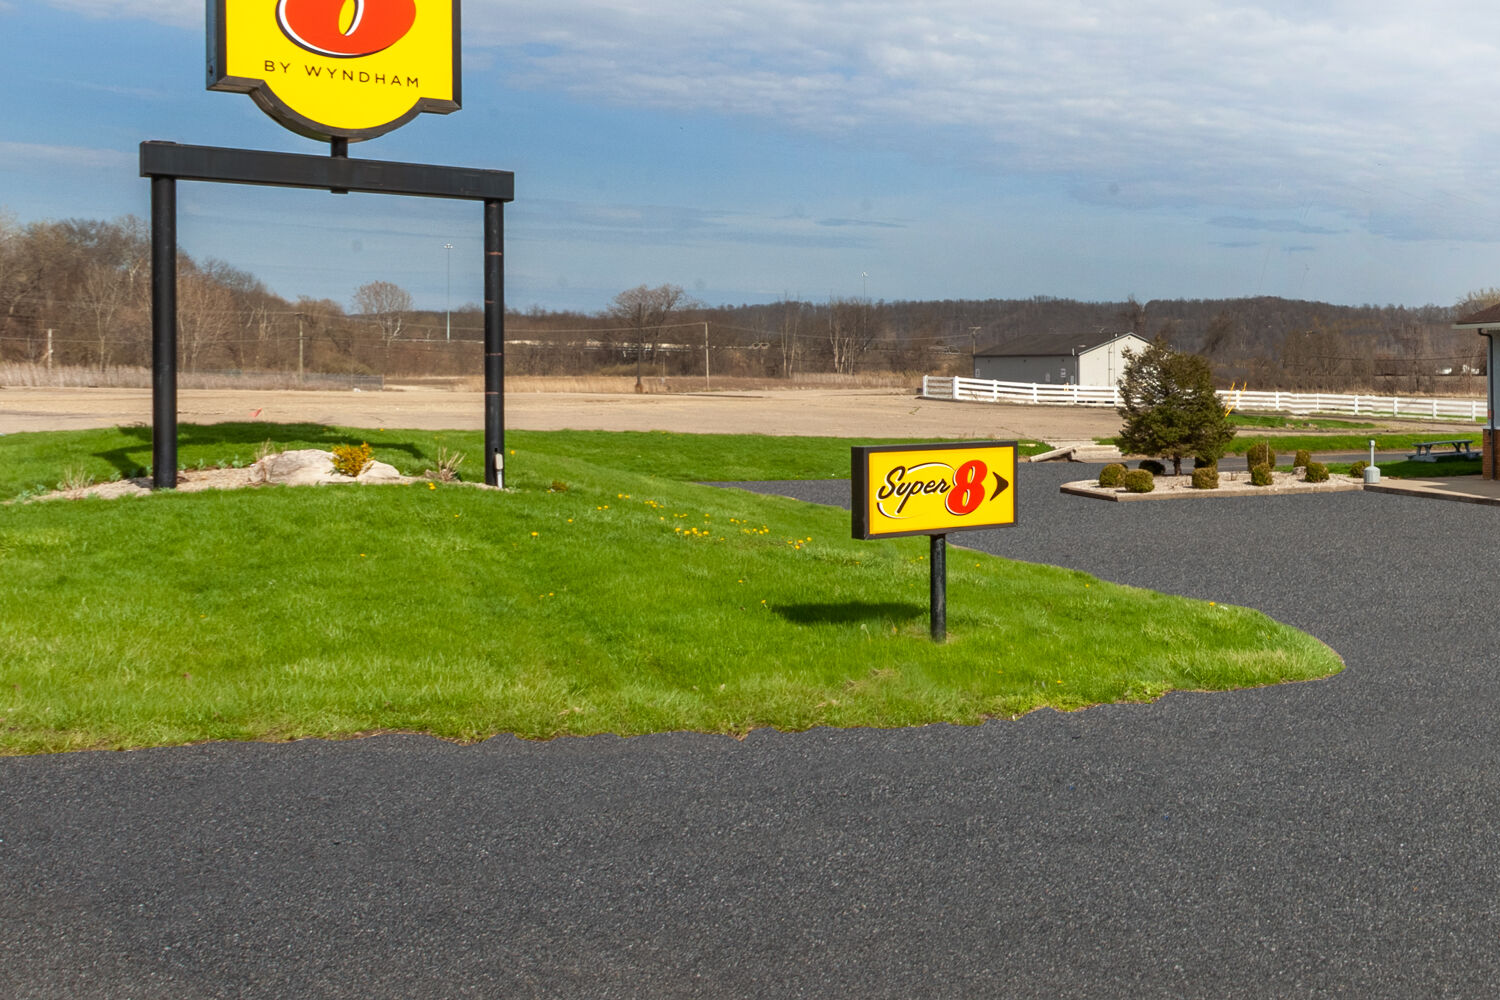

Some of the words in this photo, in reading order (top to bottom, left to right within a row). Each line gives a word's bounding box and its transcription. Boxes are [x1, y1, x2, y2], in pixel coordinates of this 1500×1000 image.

[264, 60, 291, 74] BY
[304, 64, 420, 88] WYNDHAM
[876, 465, 951, 515] Super
[944, 459, 988, 516] 8
